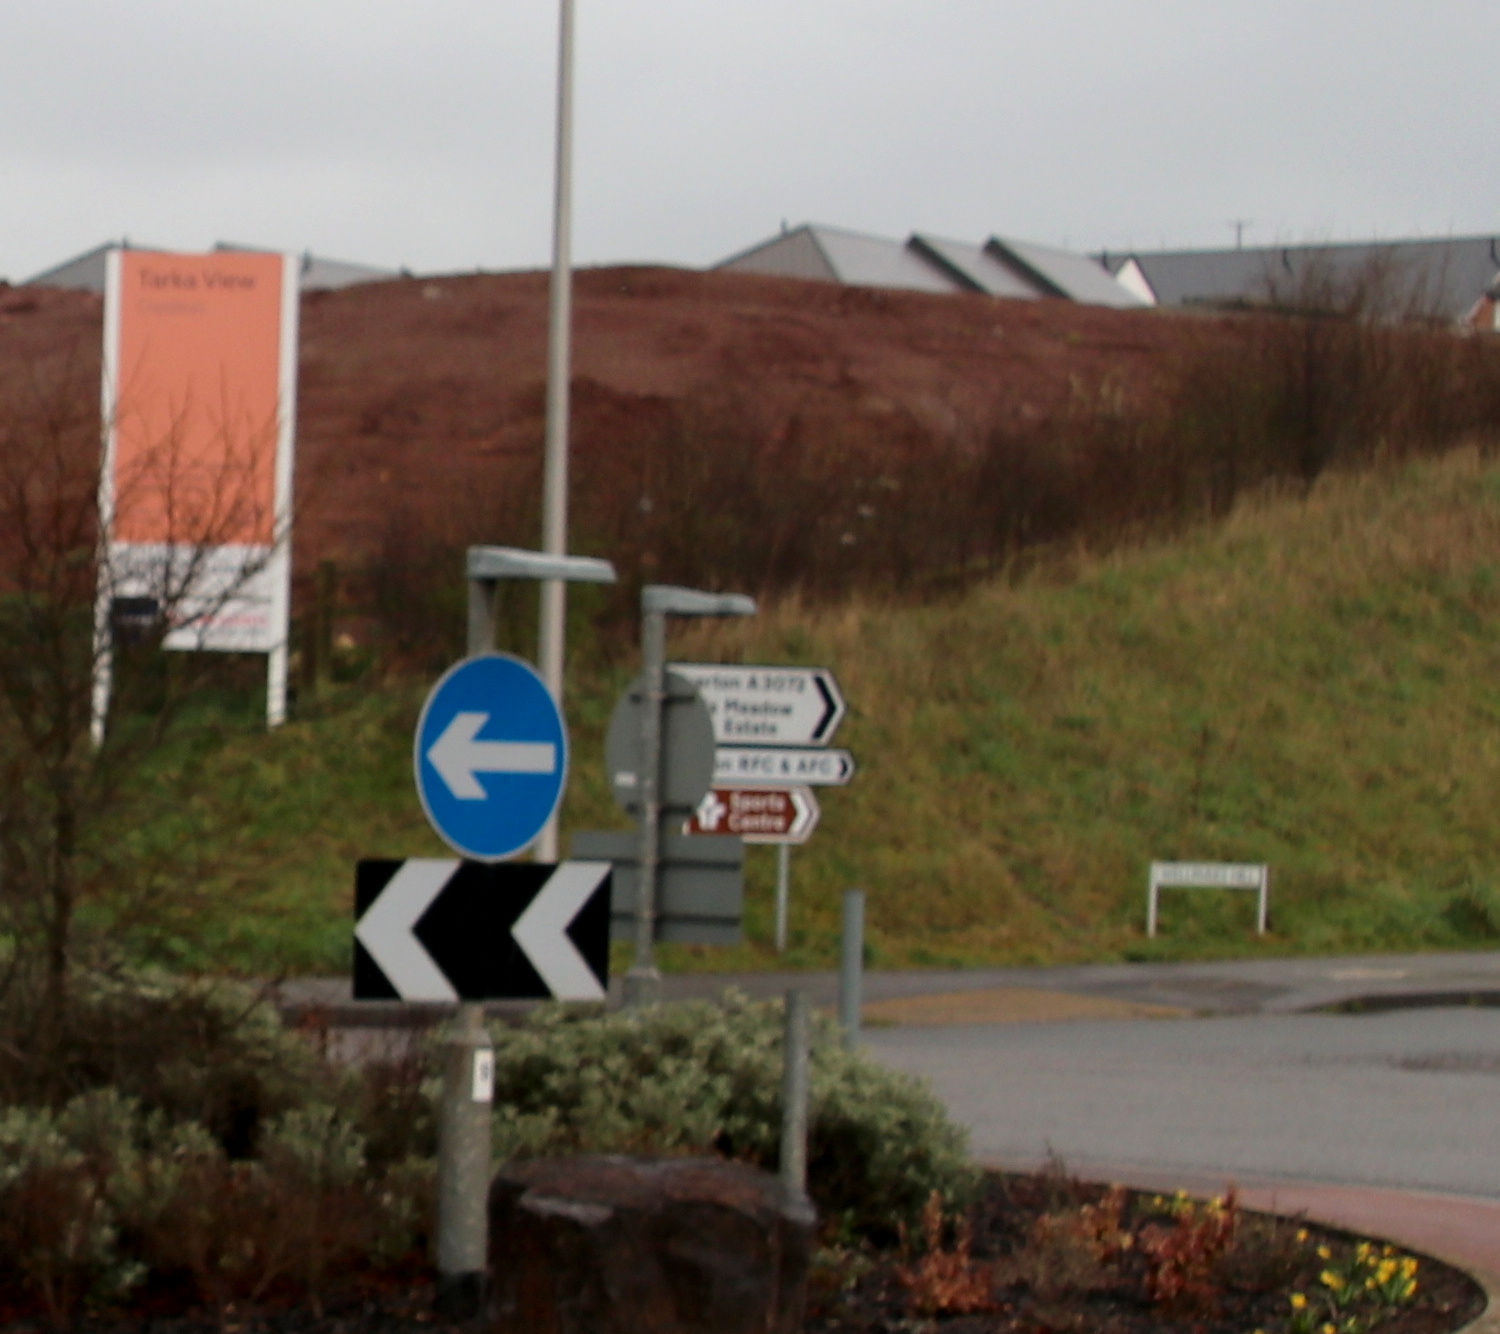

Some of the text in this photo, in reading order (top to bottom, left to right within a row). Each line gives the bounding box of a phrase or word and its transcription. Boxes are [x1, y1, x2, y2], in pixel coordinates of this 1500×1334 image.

[138, 266, 257, 289] Tarka View
[724, 699, 793, 715] Meadow
[724, 719, 778, 734] Estate
[738, 756, 775, 774] RFC
[780, 758, 791, 773] &
[797, 758, 834, 775] AFC
[729, 792, 786, 812] Sports
[728, 813, 786, 832] Centre
